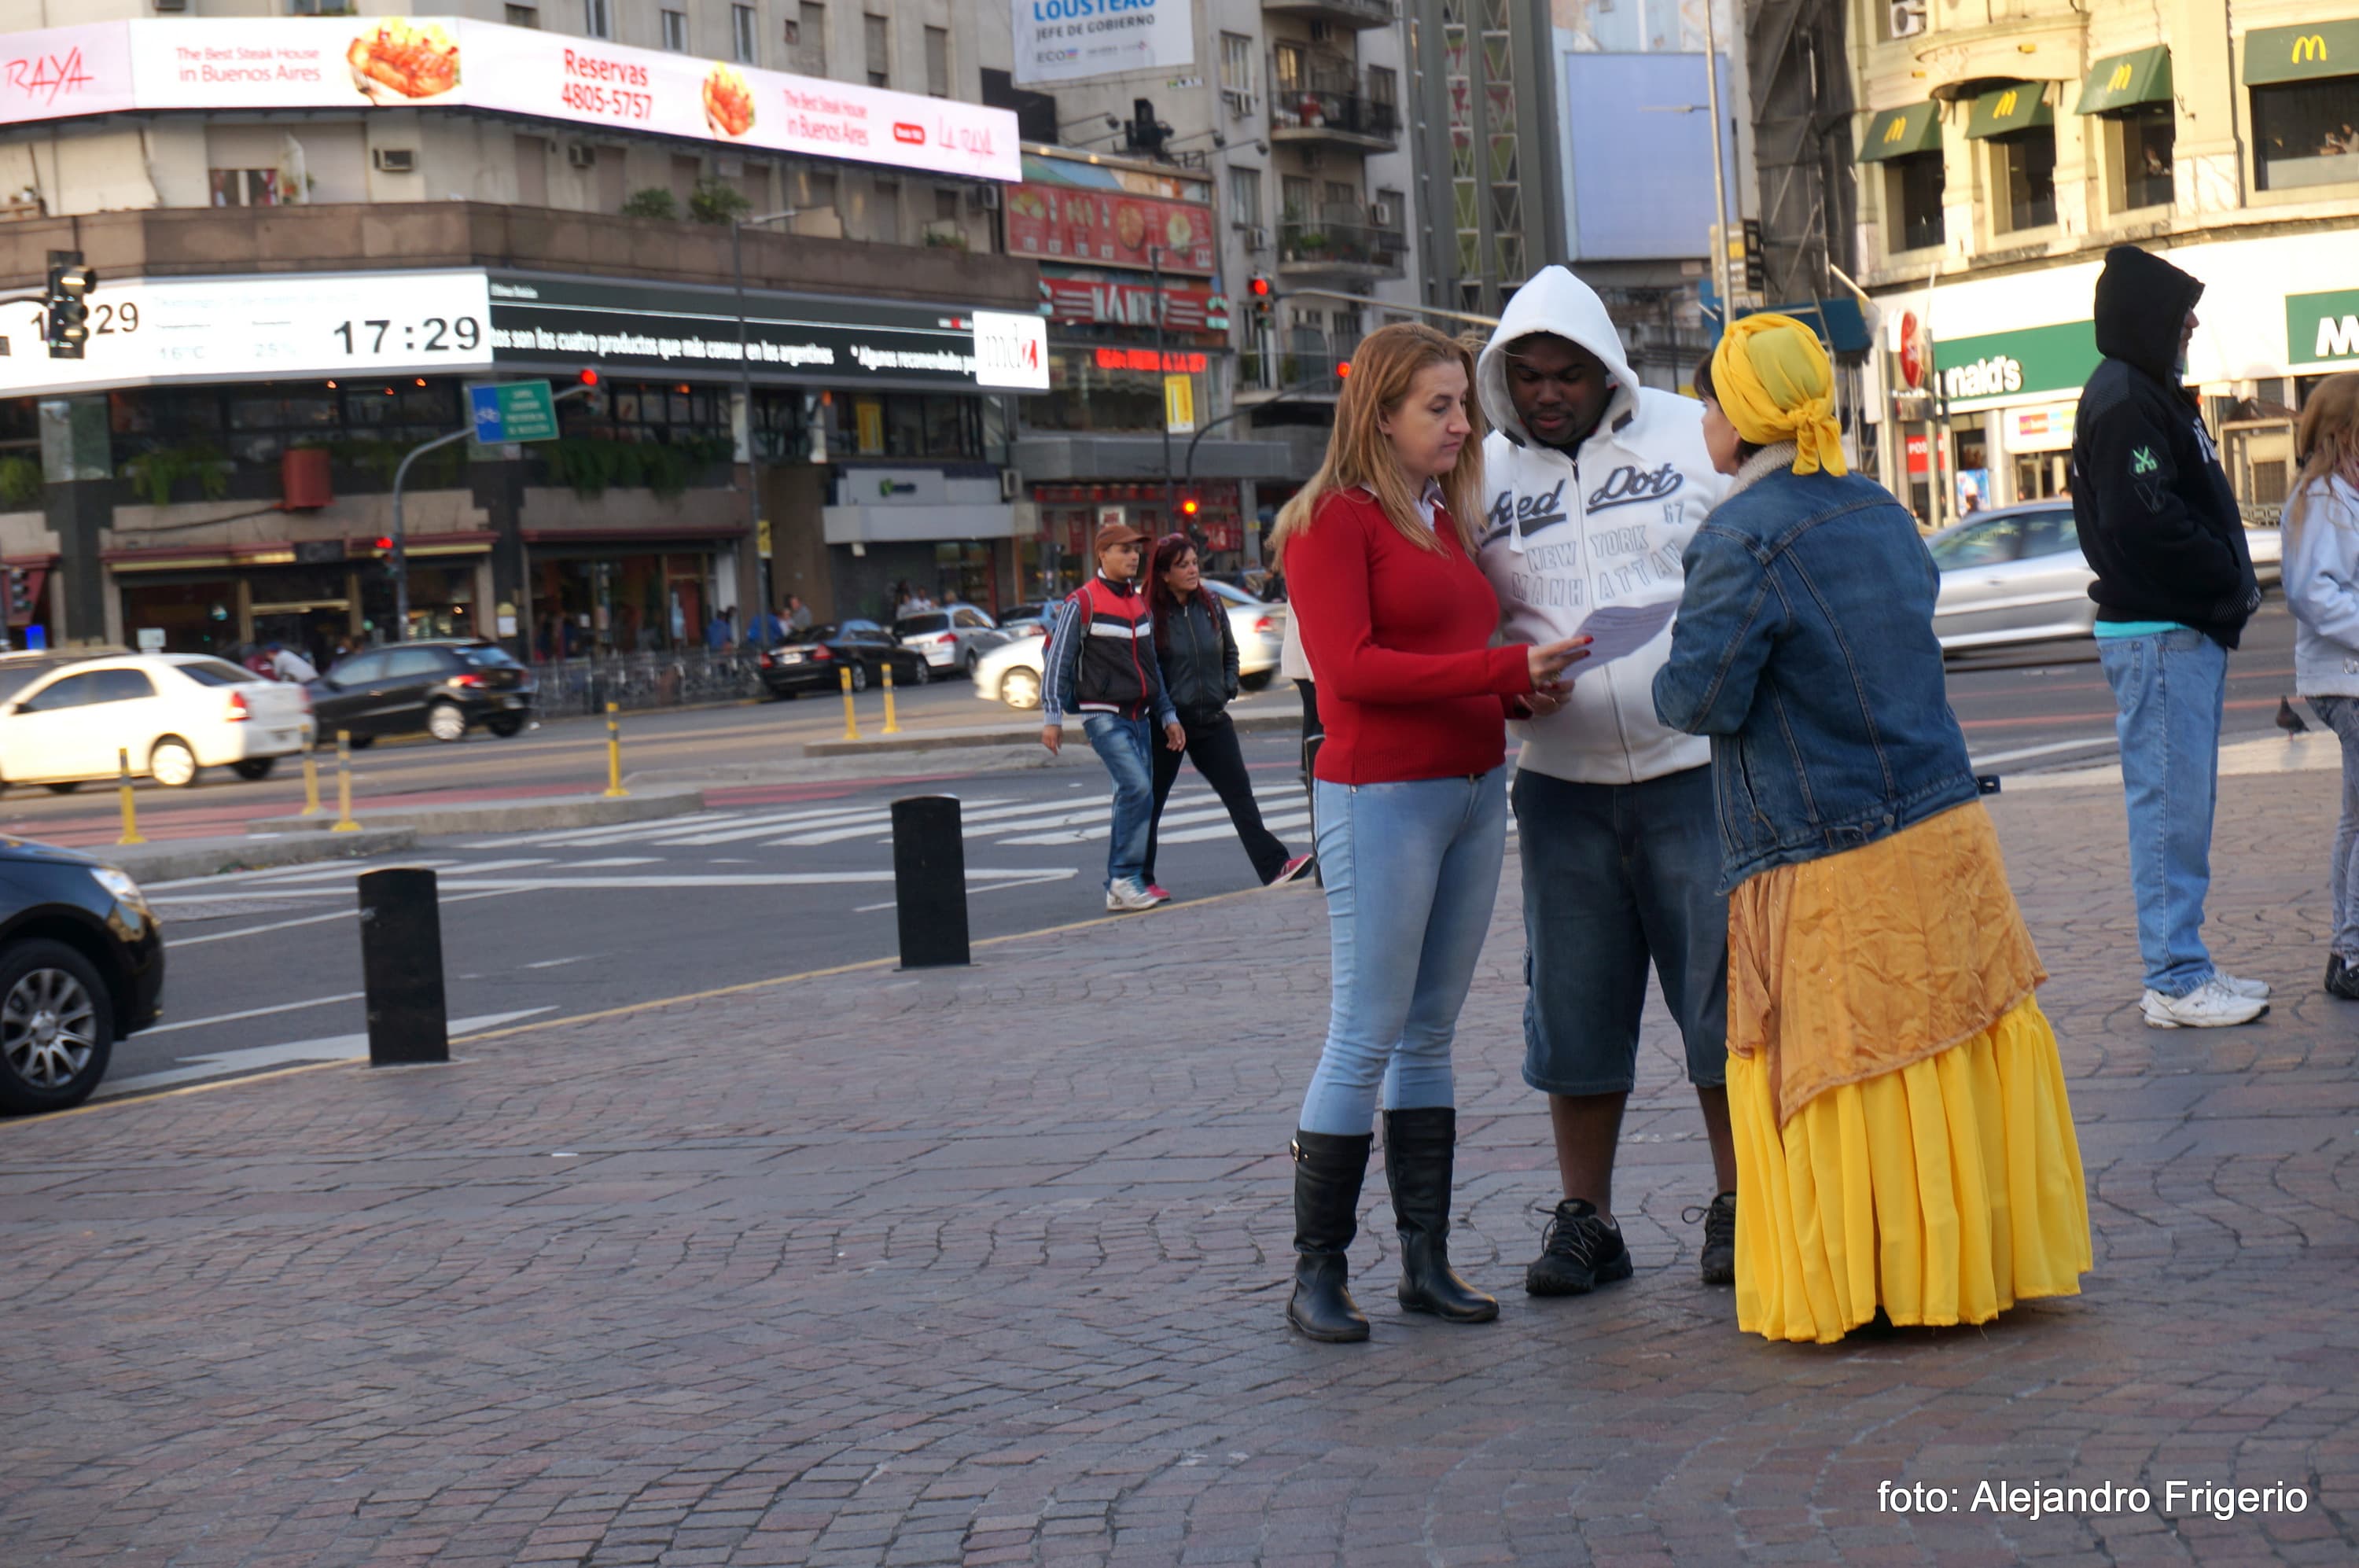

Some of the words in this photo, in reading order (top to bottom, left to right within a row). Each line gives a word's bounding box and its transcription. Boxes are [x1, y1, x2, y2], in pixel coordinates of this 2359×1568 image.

[1036, 25, 1062, 41] JEFE
[1067, 23, 1084, 36] DE
[1087, 14, 1155, 33] GOBIERNO
[175, 47, 201, 61] The
[204, 47, 234, 60] Best
[237, 47, 272, 60] Steak
[277, 48, 320, 60] House
[179, 65, 197, 82] in
[201, 64, 271, 82] Buenos
[276, 64, 322, 82] Aires
[563, 48, 648, 86] Reservas
[5, 45, 94, 107] RAYA
[561, 82, 653, 120] 4805-5757
[333, 316, 483, 355] 17:29
[598, 330, 658, 358] productos
[1525, 539, 1577, 574] NEW
[1588, 523, 1650, 559] YORK
